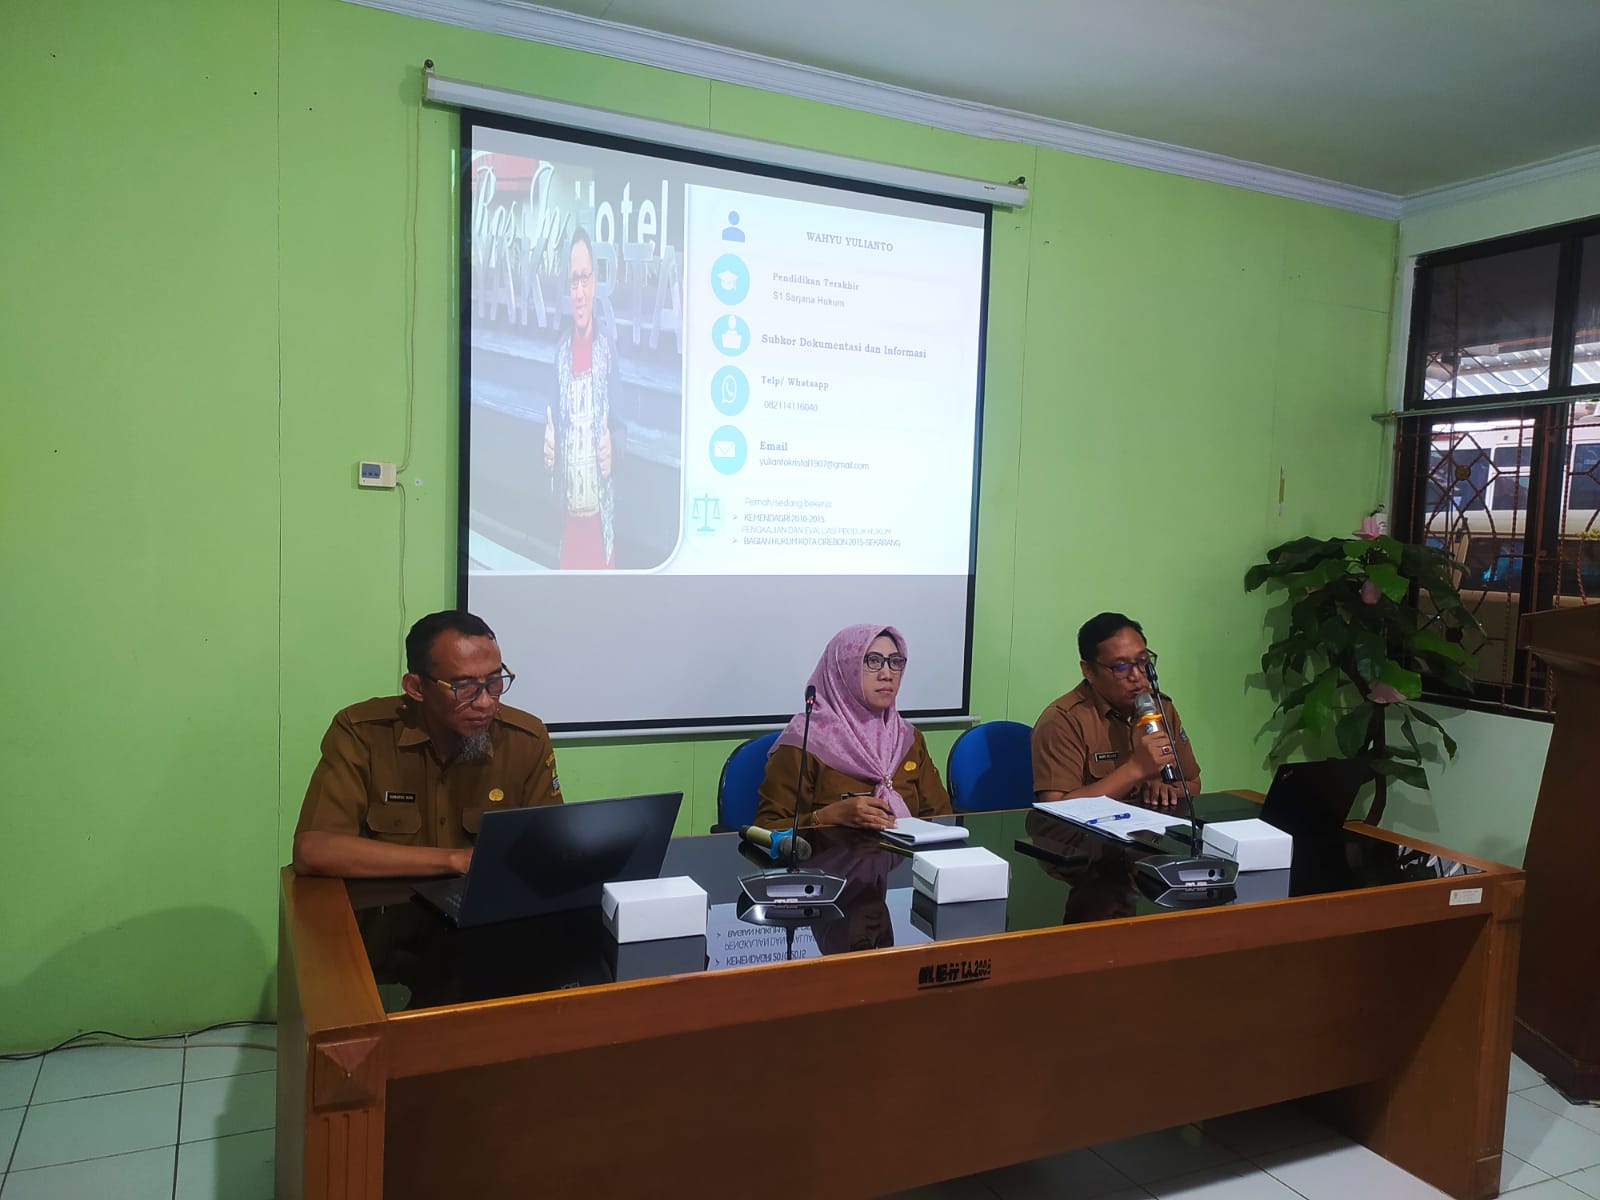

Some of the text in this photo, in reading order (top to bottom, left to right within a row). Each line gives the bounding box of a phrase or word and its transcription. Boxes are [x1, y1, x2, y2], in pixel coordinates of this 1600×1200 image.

[806, 231, 894, 252] WAHYU YULIANTO
[772, 271, 859, 291] Pendidikan Terakhir
[773, 290, 845, 307] S1 Sarjana Hukum
[761, 333, 927, 359] Subkor Dokumentasi dan Informasi
[760, 375, 829, 391] Telp/ Whatsapp
[759, 440, 788, 452] Email
[743, 513, 790, 523] KEMENDAGRI
[788, 527, 803, 536] DAN
[798, 537, 818, 547] KOTA
